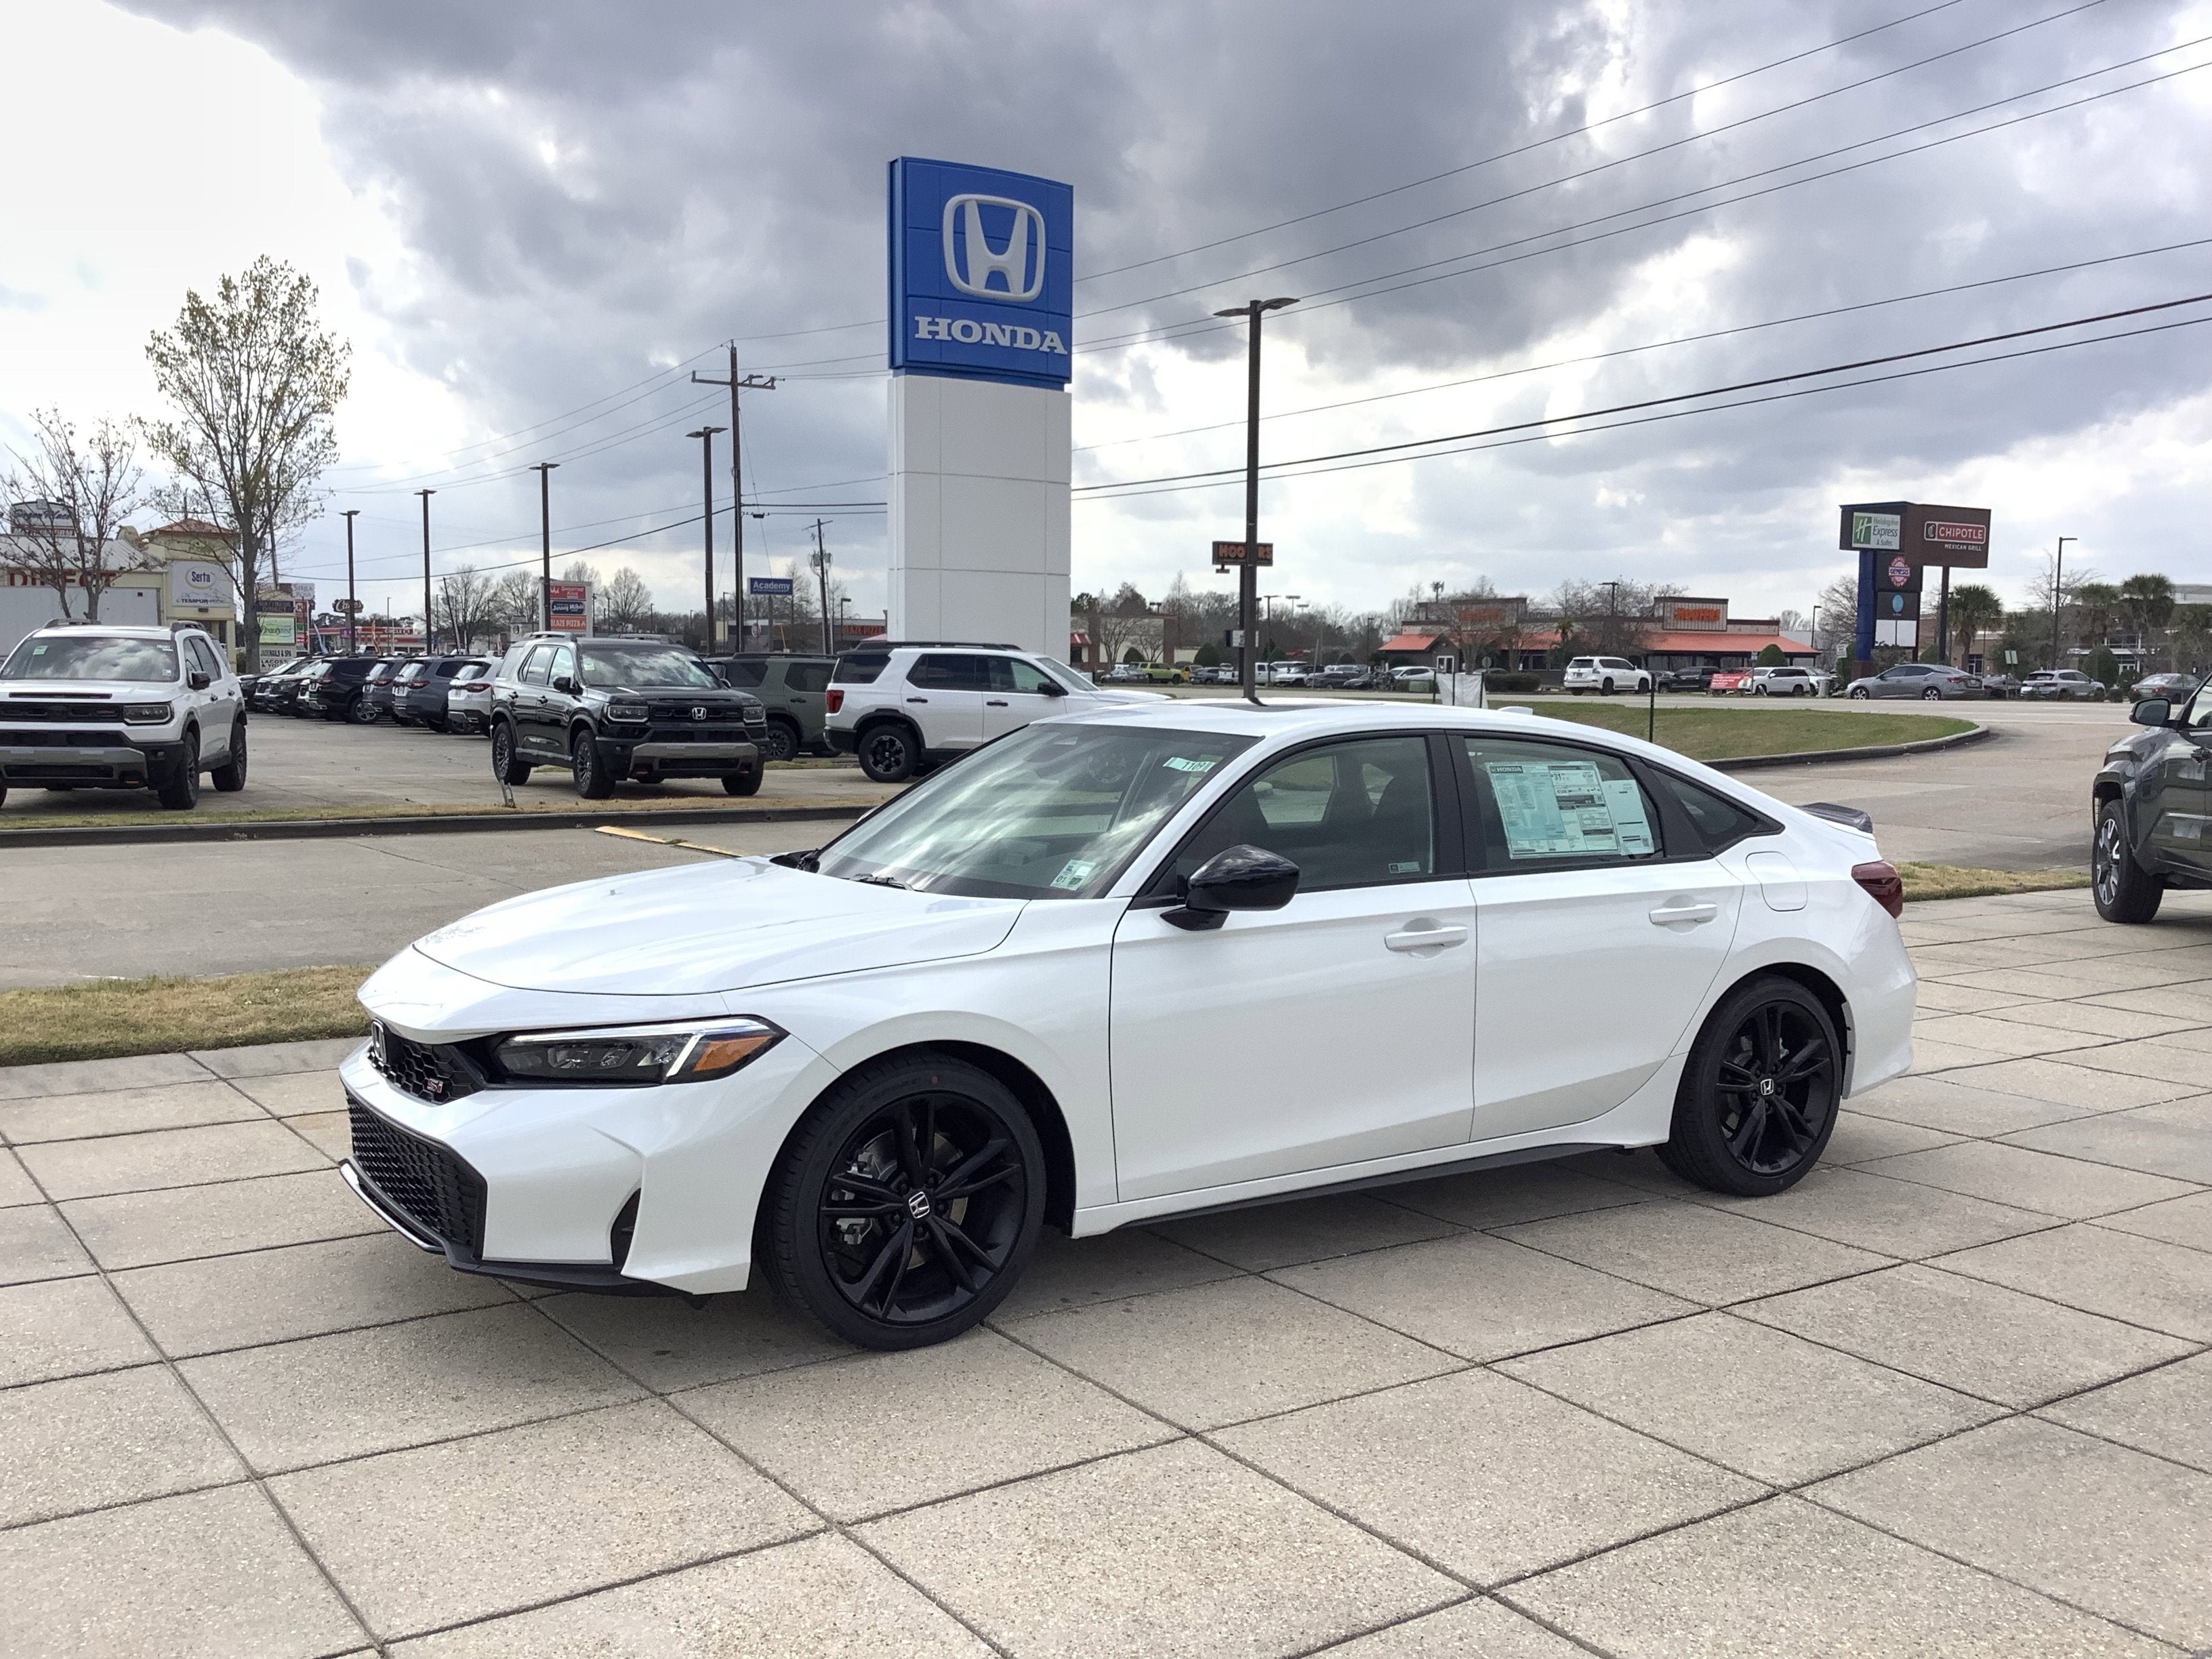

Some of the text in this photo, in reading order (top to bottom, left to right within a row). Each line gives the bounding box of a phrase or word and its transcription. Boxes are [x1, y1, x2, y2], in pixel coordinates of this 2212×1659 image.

[915, 316, 1067, 355] HONDA
[1872, 525, 1898, 539] Express
[1939, 527, 1983, 540] CHIPOTLE
[1218, 544, 1273, 560] HOORS
[191, 571, 211, 583] Serta
[753, 581, 790, 592] Academy
[566, 619, 581, 628] PIZZA
[427, 1078, 443, 1093] Si
